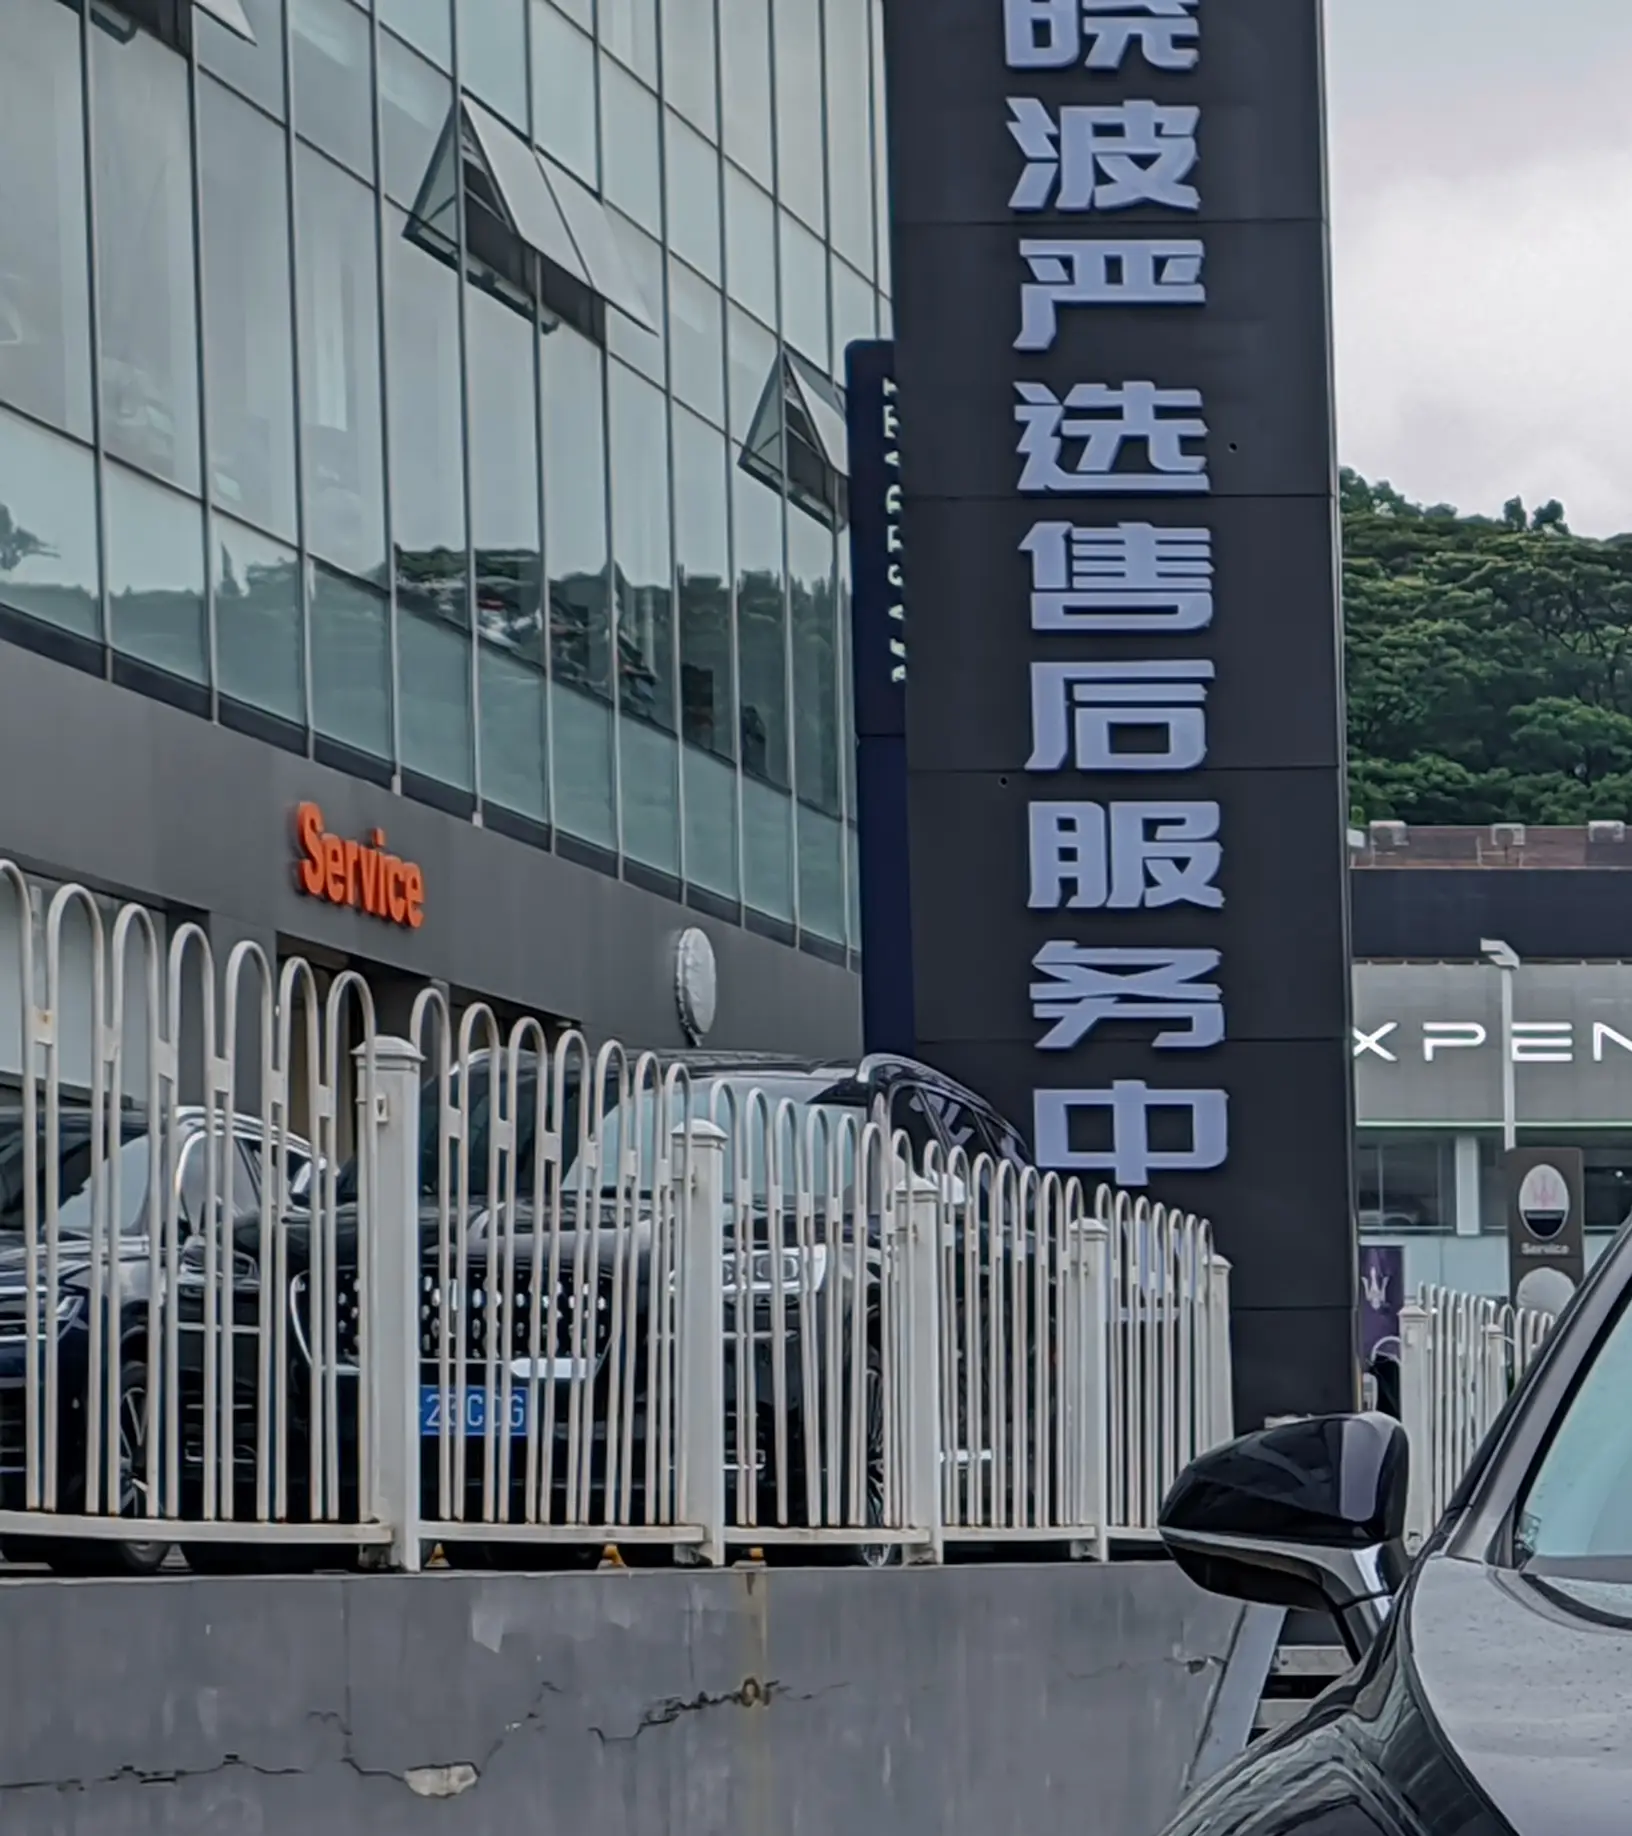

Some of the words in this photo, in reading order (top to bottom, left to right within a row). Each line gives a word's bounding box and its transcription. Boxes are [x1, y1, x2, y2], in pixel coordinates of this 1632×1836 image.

[1002, 0, 1229, 1322] 晓波严选售后服务中
[297, 802, 425, 928] Service
[1521, 1242, 1570, 1255] Service
